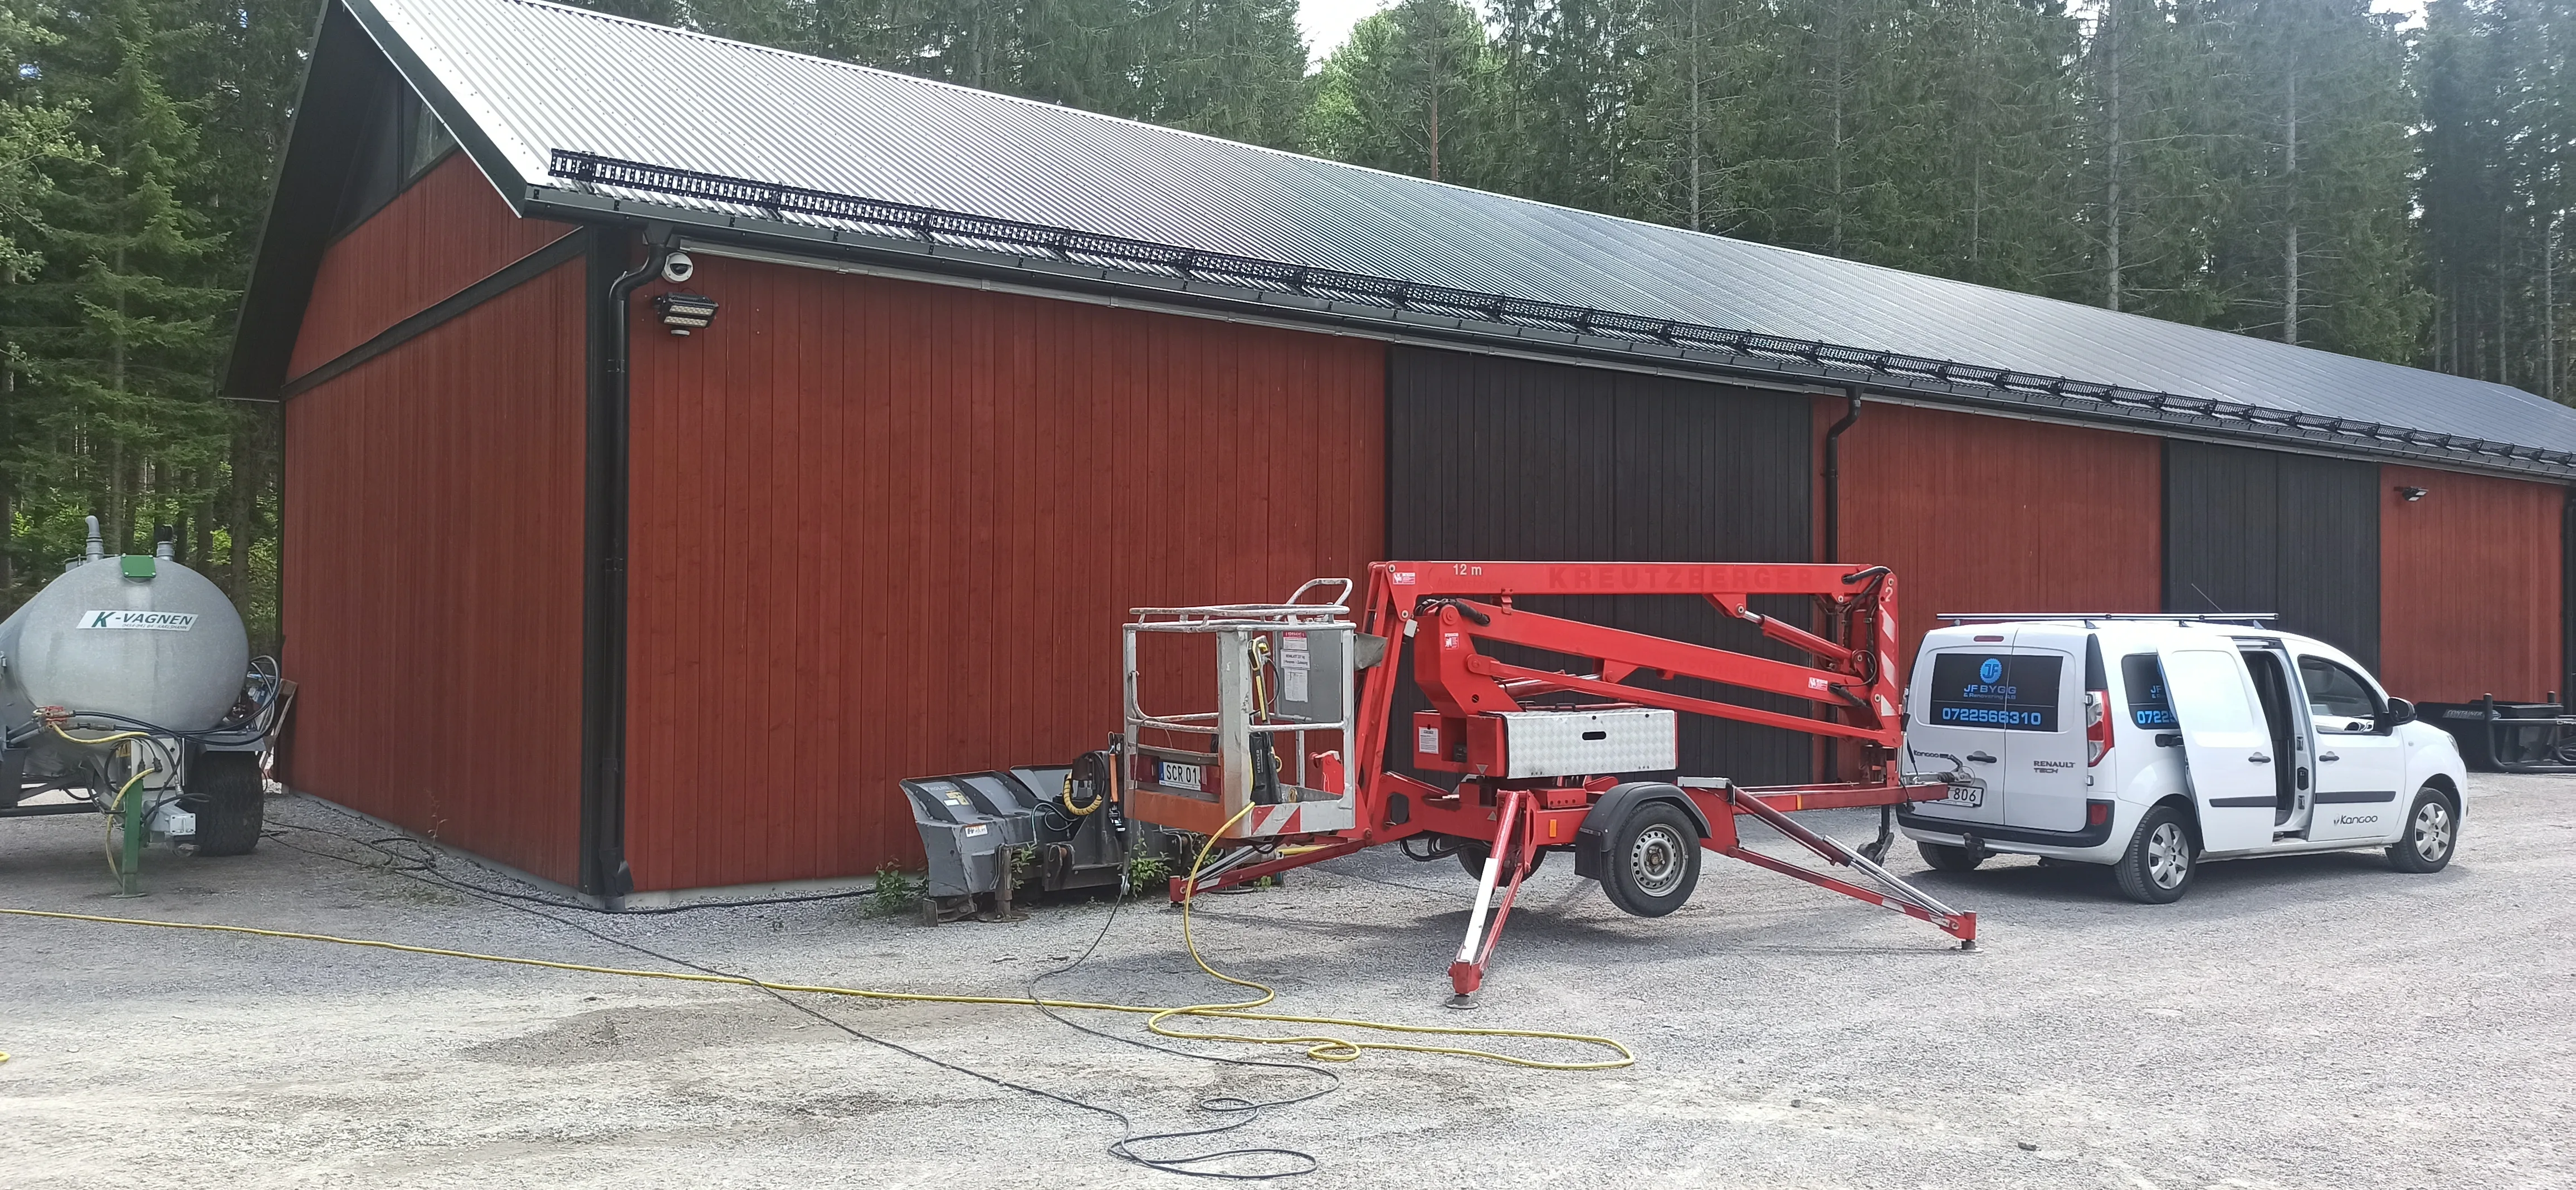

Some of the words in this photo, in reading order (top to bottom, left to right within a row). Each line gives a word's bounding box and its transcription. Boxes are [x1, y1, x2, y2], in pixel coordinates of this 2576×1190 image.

[1453, 564, 1467, 575] 12
[1471, 566, 1482, 576] m
[1548, 567, 1813, 589] KREUTZBERGER
[1885, 587, 1893, 602] 2
[1980, 685, 2017, 694] BYGG
[1943, 708, 2041, 725] 0722566310
[1167, 764, 1183, 782] SCR
[1186, 767, 1201, 784] 01
[1954, 788, 1976, 802] 806
[2340, 815, 2378, 825] Kangoo
